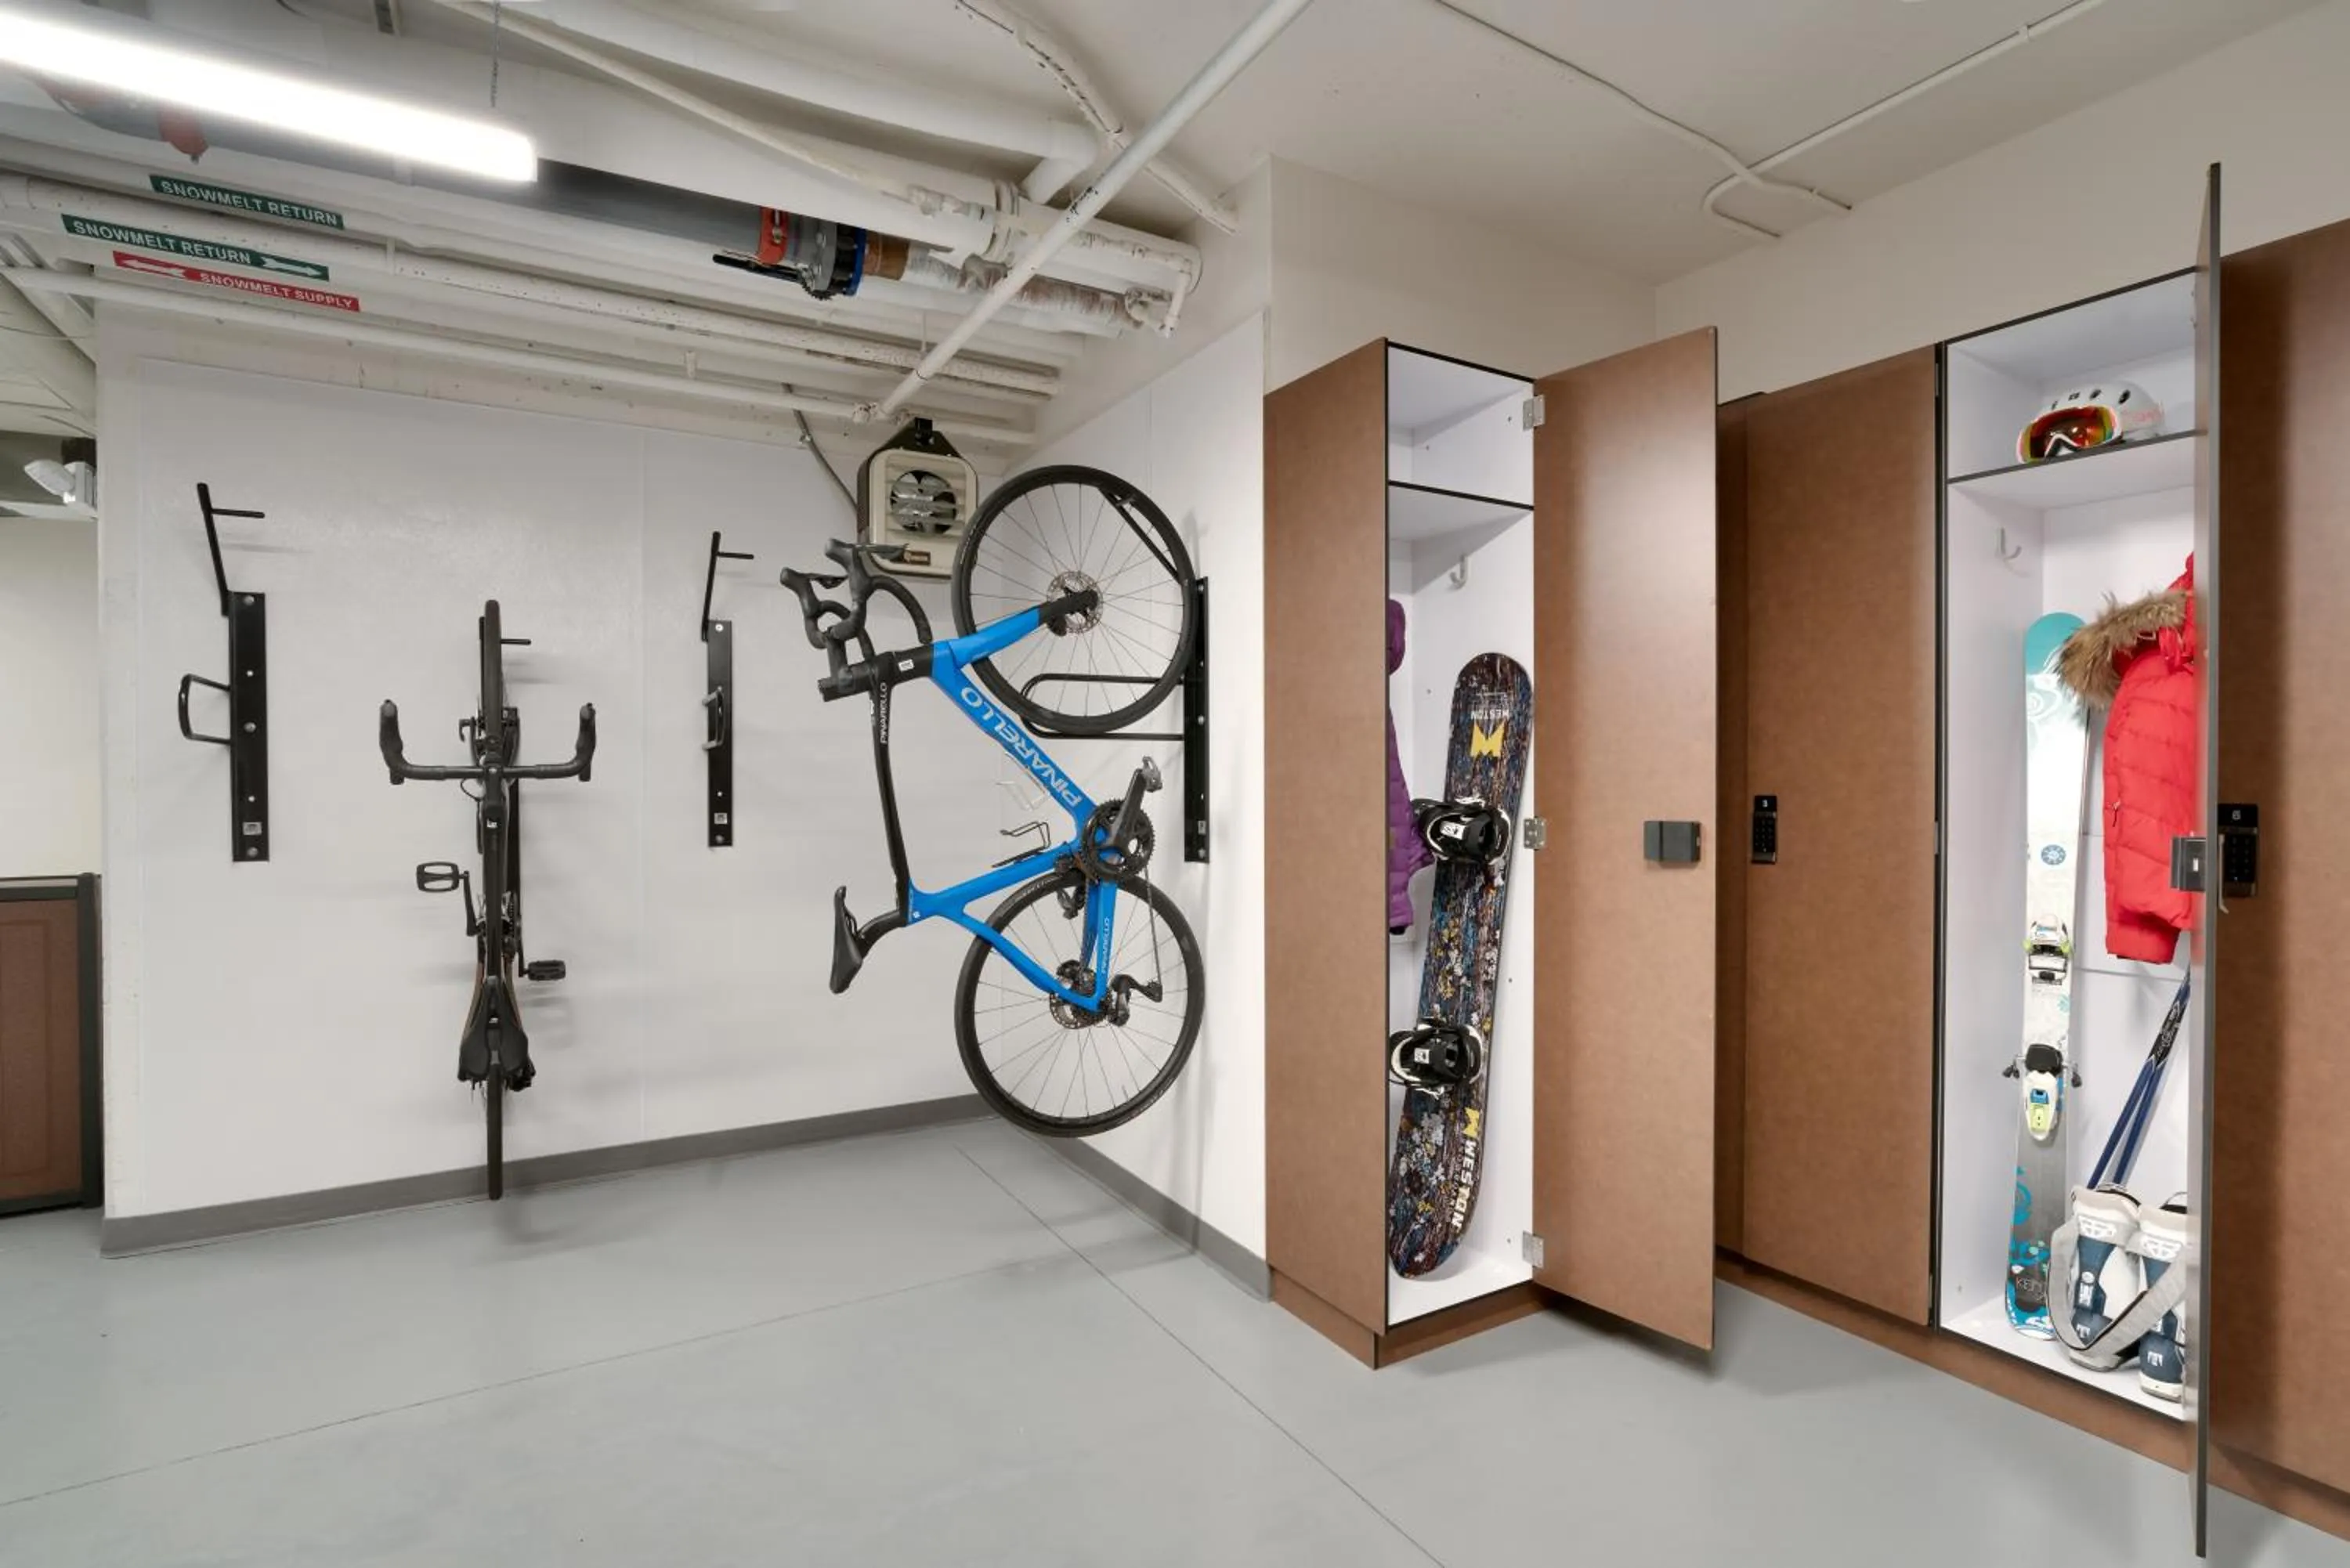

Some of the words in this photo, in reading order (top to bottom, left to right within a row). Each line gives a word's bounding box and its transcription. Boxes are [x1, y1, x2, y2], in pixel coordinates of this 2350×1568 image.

[161, 181, 262, 211] SNOWMELT
[269, 201, 338, 226] RETURN
[74, 220, 175, 251] SNOWMELT
[181, 240, 251, 264] RETURN
[200, 273, 291, 297] SNOWMELT
[294, 289, 353, 308] SUPPLY
[879, 681, 888, 744] PINARELLO
[960, 687, 1083, 807] PINARELLO
[1451, 1139, 1477, 1233] WESTON
